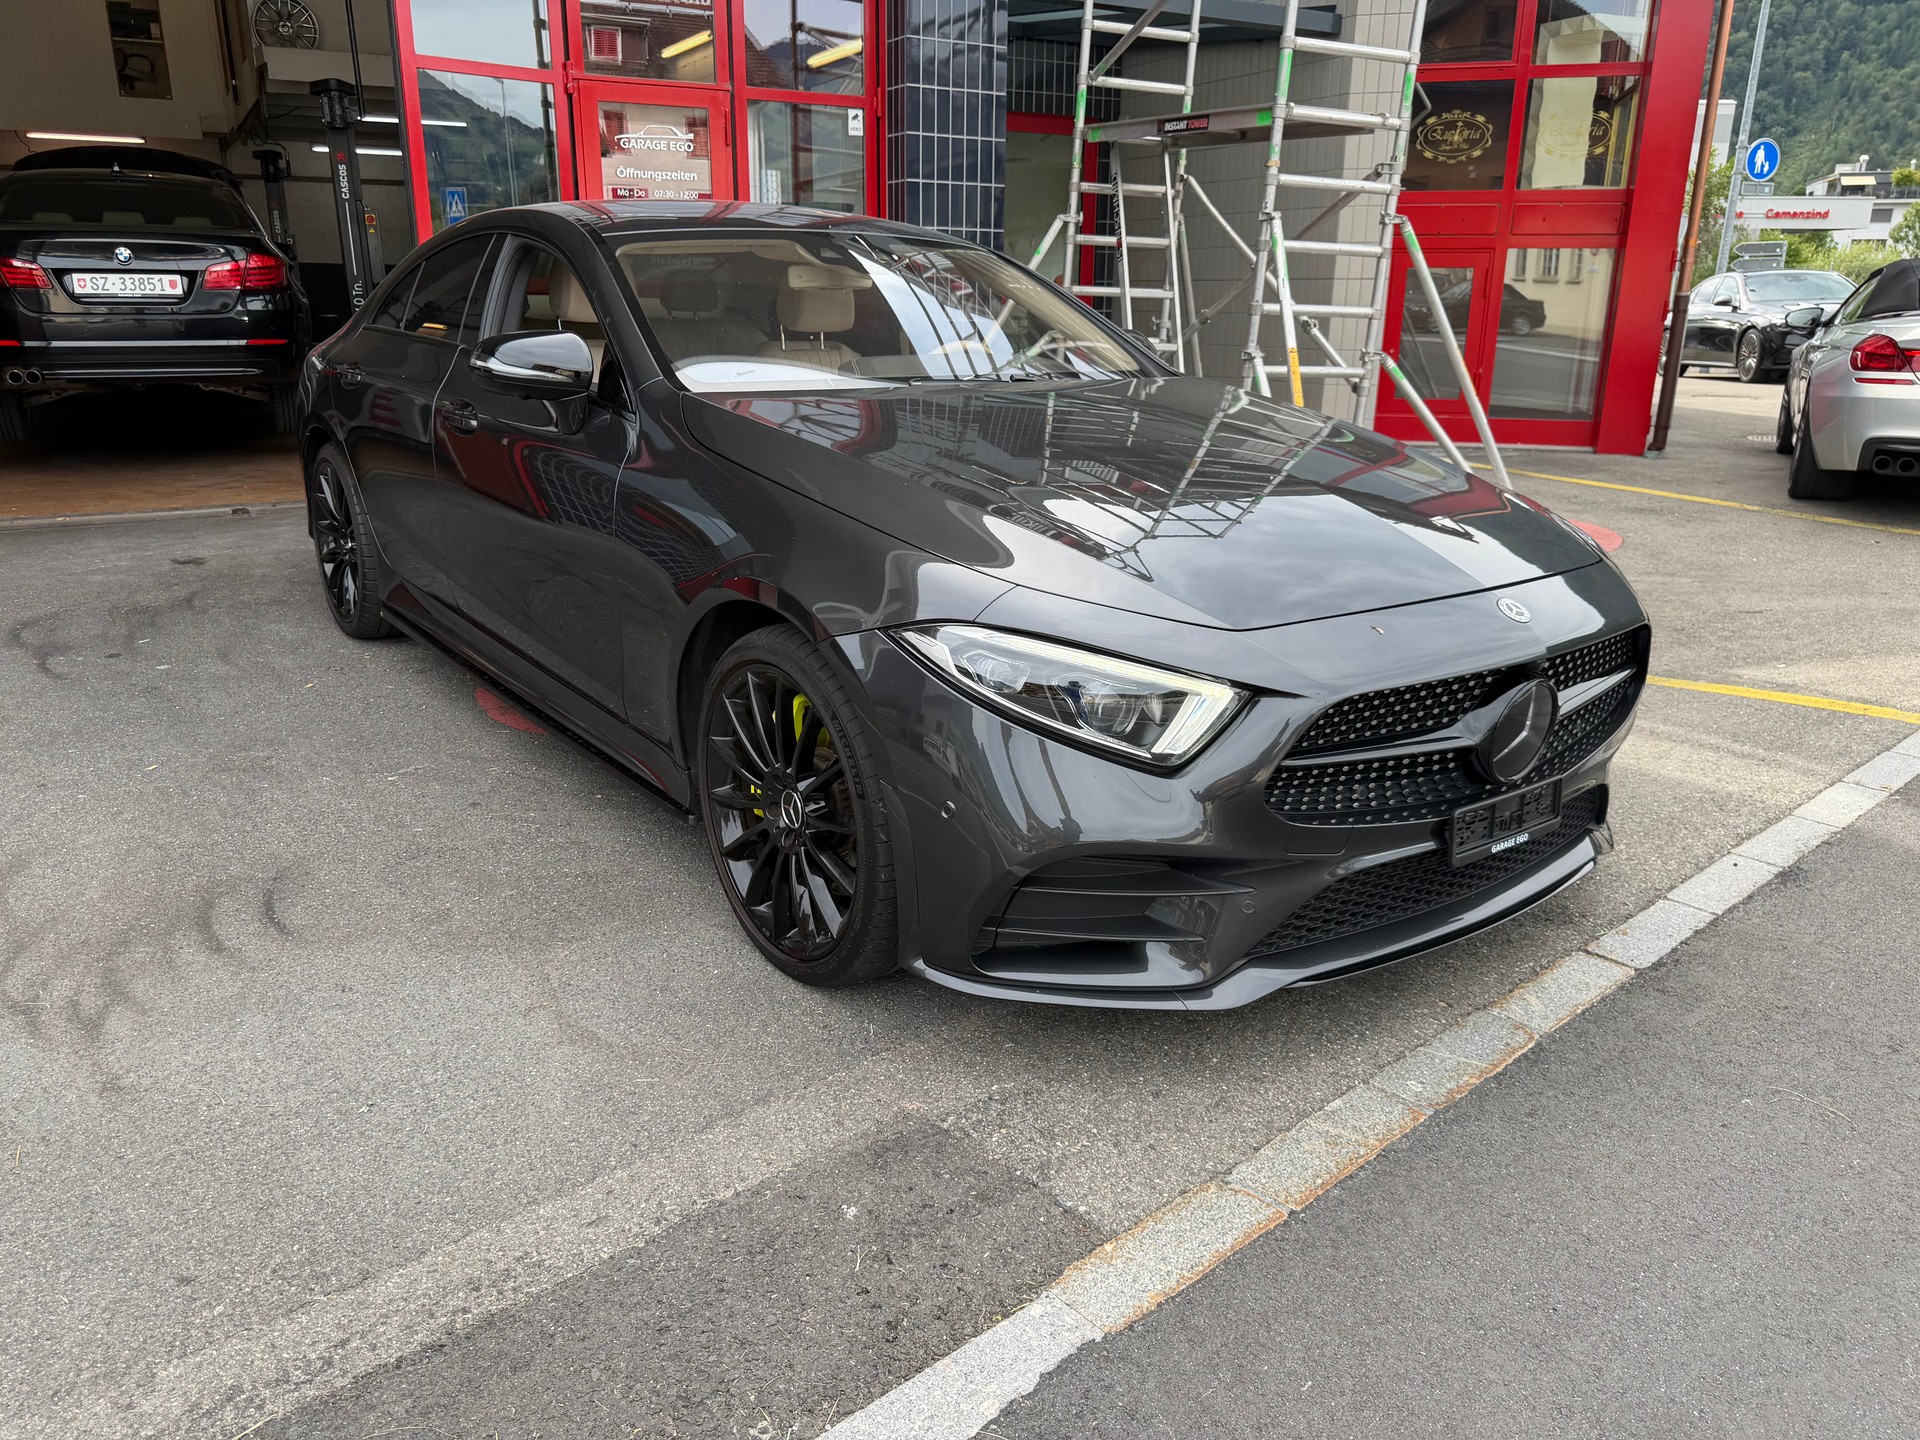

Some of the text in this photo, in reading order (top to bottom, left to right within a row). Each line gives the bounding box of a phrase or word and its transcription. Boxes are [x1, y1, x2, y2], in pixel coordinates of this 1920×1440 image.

[1164, 118, 1208, 131] INSTANT TOWER
[620, 138, 694, 152] GARAGE EGO
[616, 166, 698, 181] Öffnungszeiten
[338, 164, 350, 199] CASCOS
[617, 188, 629, 196] Mo
[634, 189, 646, 198] Do
[654, 189, 674, 199] 07:30
[90, 276, 110, 291] SZ
[119, 277, 166, 292] 33851
[832, 719, 864, 794] MICHELIN
[1491, 833, 1529, 853] GARAGE EGO
